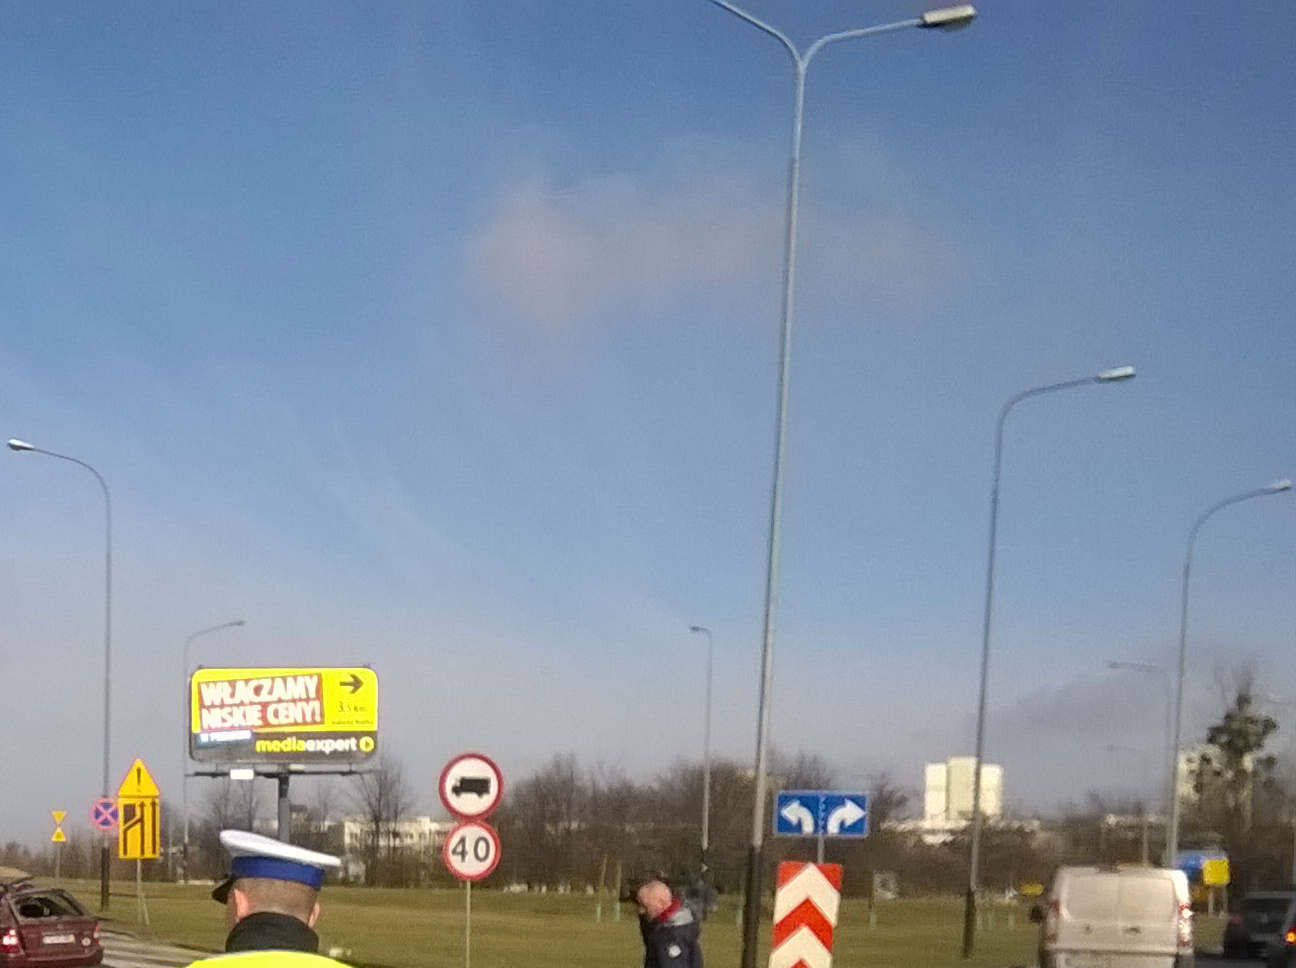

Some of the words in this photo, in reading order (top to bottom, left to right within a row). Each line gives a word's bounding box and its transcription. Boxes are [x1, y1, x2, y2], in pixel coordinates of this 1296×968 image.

[201, 704, 263, 729] NISKIE
[266, 700, 321, 725] CENY!
[256, 736, 357, 755] mediaexpert
[451, 836, 491, 863] 40
